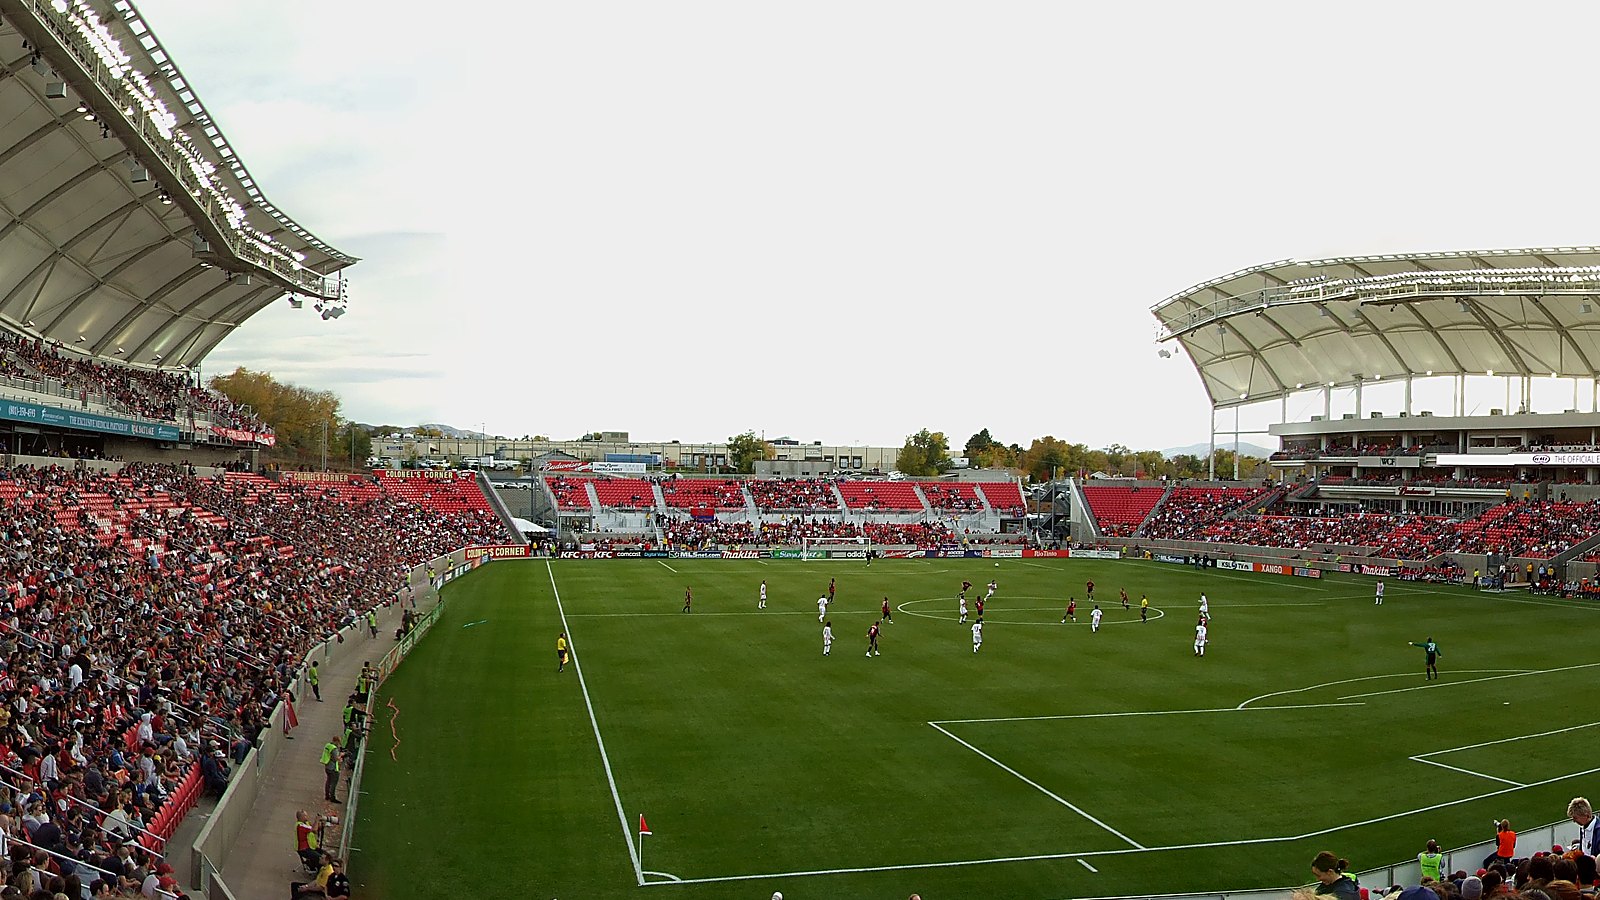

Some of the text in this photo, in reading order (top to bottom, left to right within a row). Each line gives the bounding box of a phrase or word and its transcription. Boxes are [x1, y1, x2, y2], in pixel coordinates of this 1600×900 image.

[1554, 455, 1566, 463] THE
[1567, 455, 1595, 463] OFFICIAL
[543, 461, 582, 471] Budweiser
[293, 472, 349, 482] COLONEL'S CORNER
[385, 470, 453, 479] COLONEL'S CORNER
[495, 547, 525, 556] CORNER
[560, 551, 580, 559] KFC
[594, 551, 613, 559] KFC
[1261, 564, 1283, 574] XANGO
